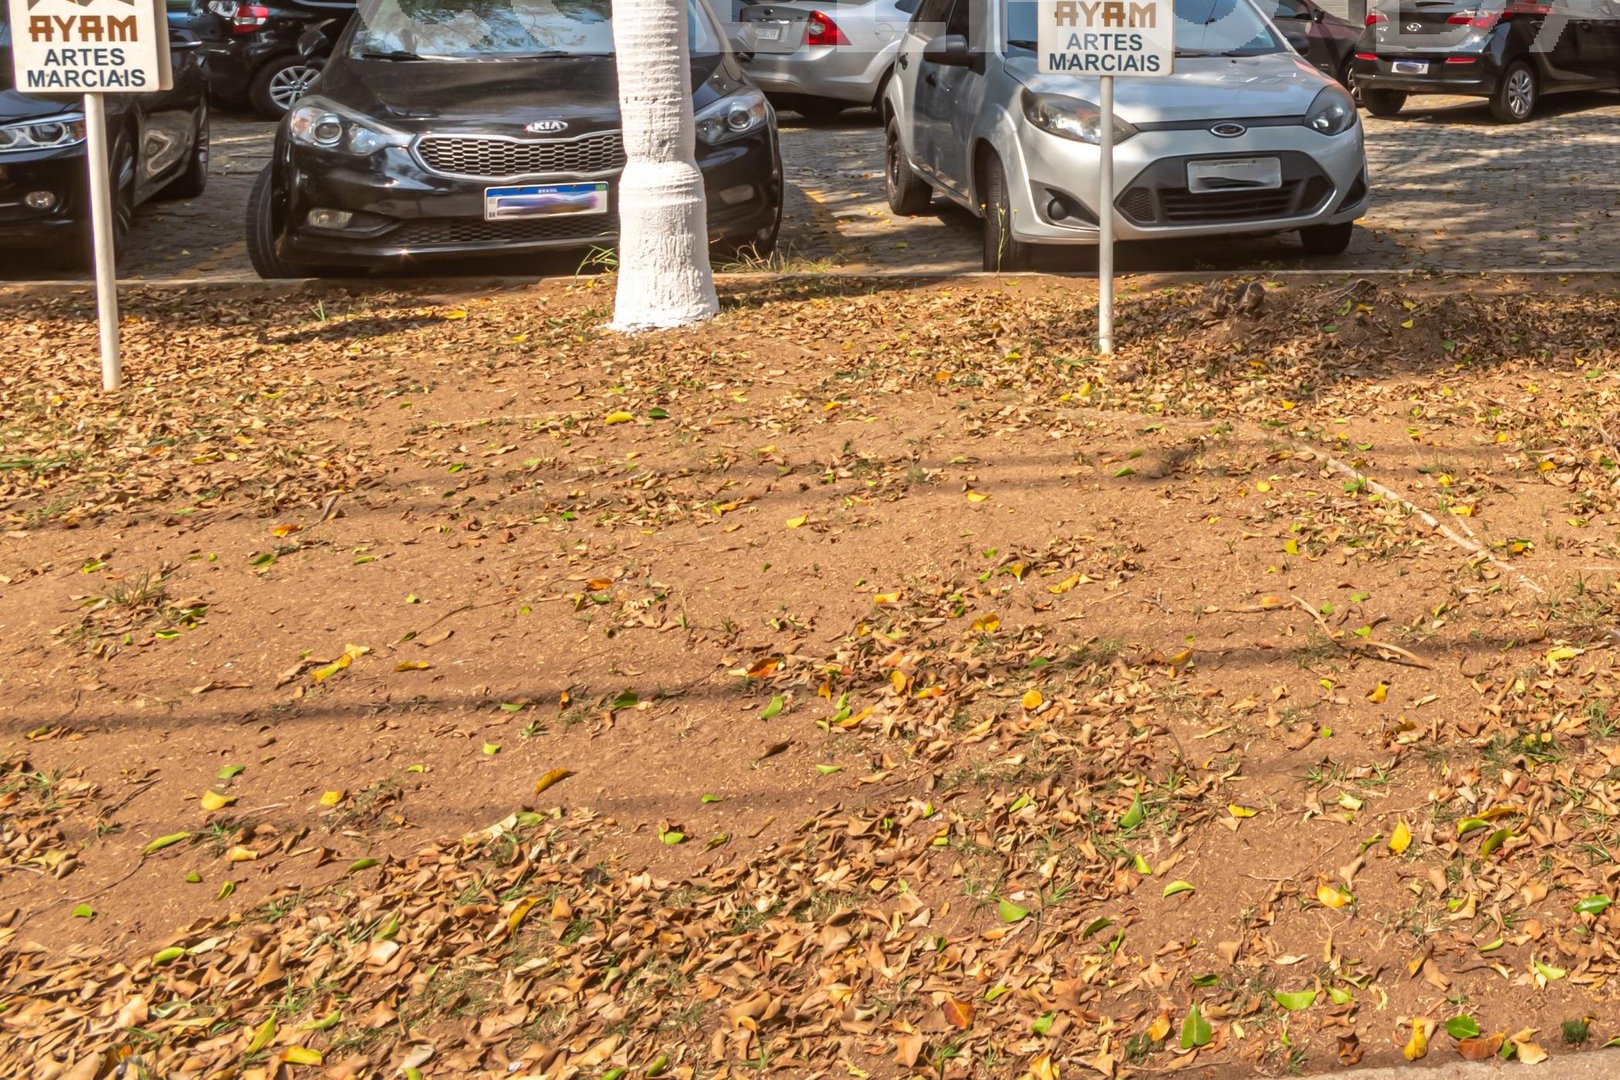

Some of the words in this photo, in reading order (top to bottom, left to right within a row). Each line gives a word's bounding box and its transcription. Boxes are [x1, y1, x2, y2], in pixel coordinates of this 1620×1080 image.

[1054, 1, 1156, 28] AYAM
[28, 15, 138, 42] AYAM
[1066, 33, 1143, 51] ARTES
[44, 48, 125, 66] ARTES
[1049, 53, 1160, 72] MARCIAIS
[27, 69, 146, 88] MARCIAIS
[534, 120, 560, 130] KIA
